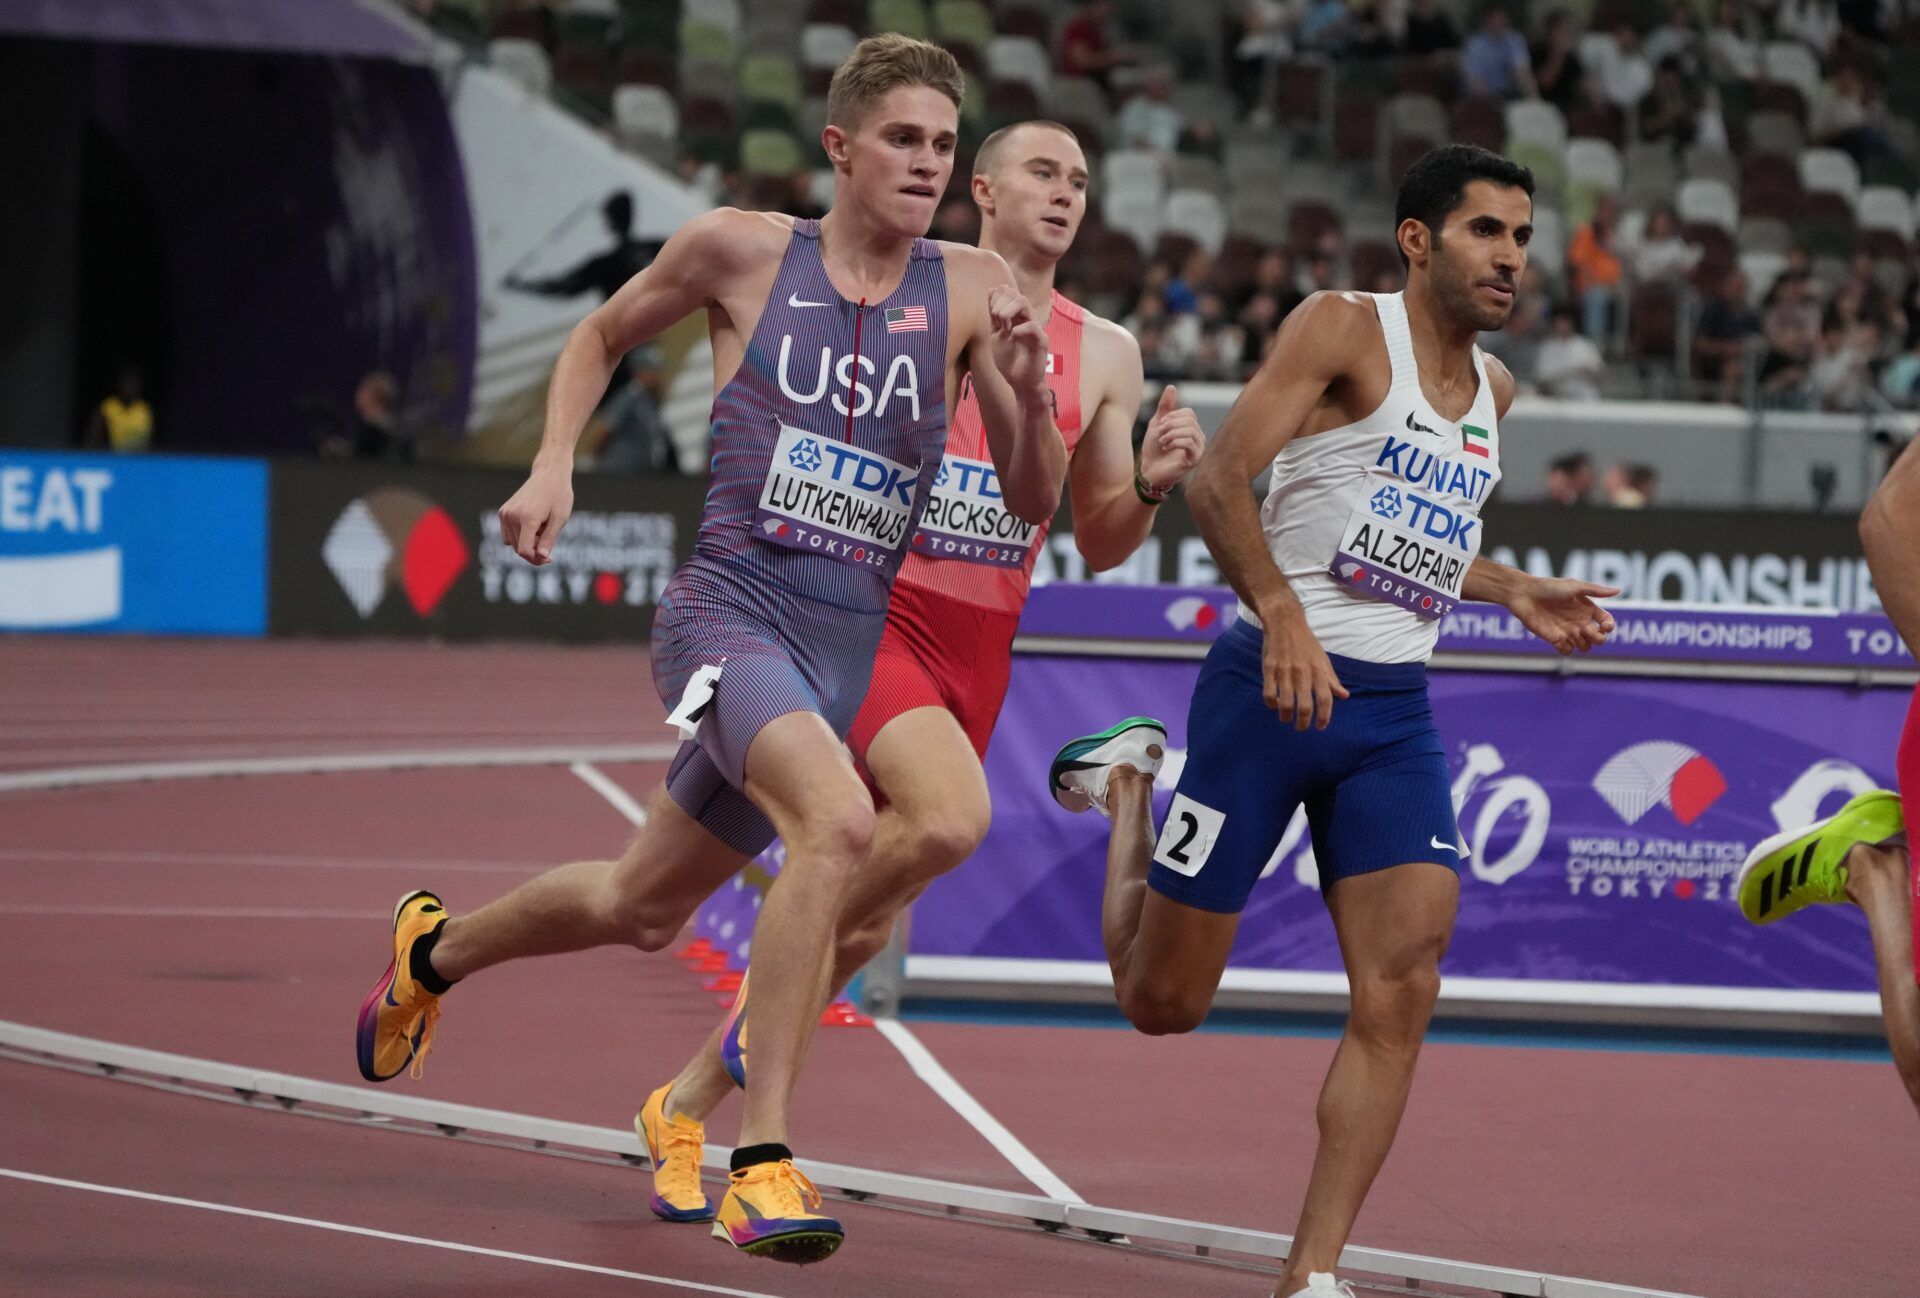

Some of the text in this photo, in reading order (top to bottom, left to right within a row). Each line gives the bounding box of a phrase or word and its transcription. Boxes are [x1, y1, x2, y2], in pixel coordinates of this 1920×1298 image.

[777, 335, 920, 421] USA
[1, 466, 113, 534] EAT
[825, 444, 917, 506] TDK
[951, 461, 1004, 499] TD
[768, 473, 906, 544] LUTKENHAUS
[923, 496, 1032, 542] RICKSON
[1405, 493, 1476, 551] TDK
[1349, 523, 1465, 593] ALZOFAIRI
[1606, 622, 1813, 651] HAMPIONSHIPS
[1166, 811, 1200, 866] 2
[1568, 838, 1748, 861] WORLD ATHLETICS
